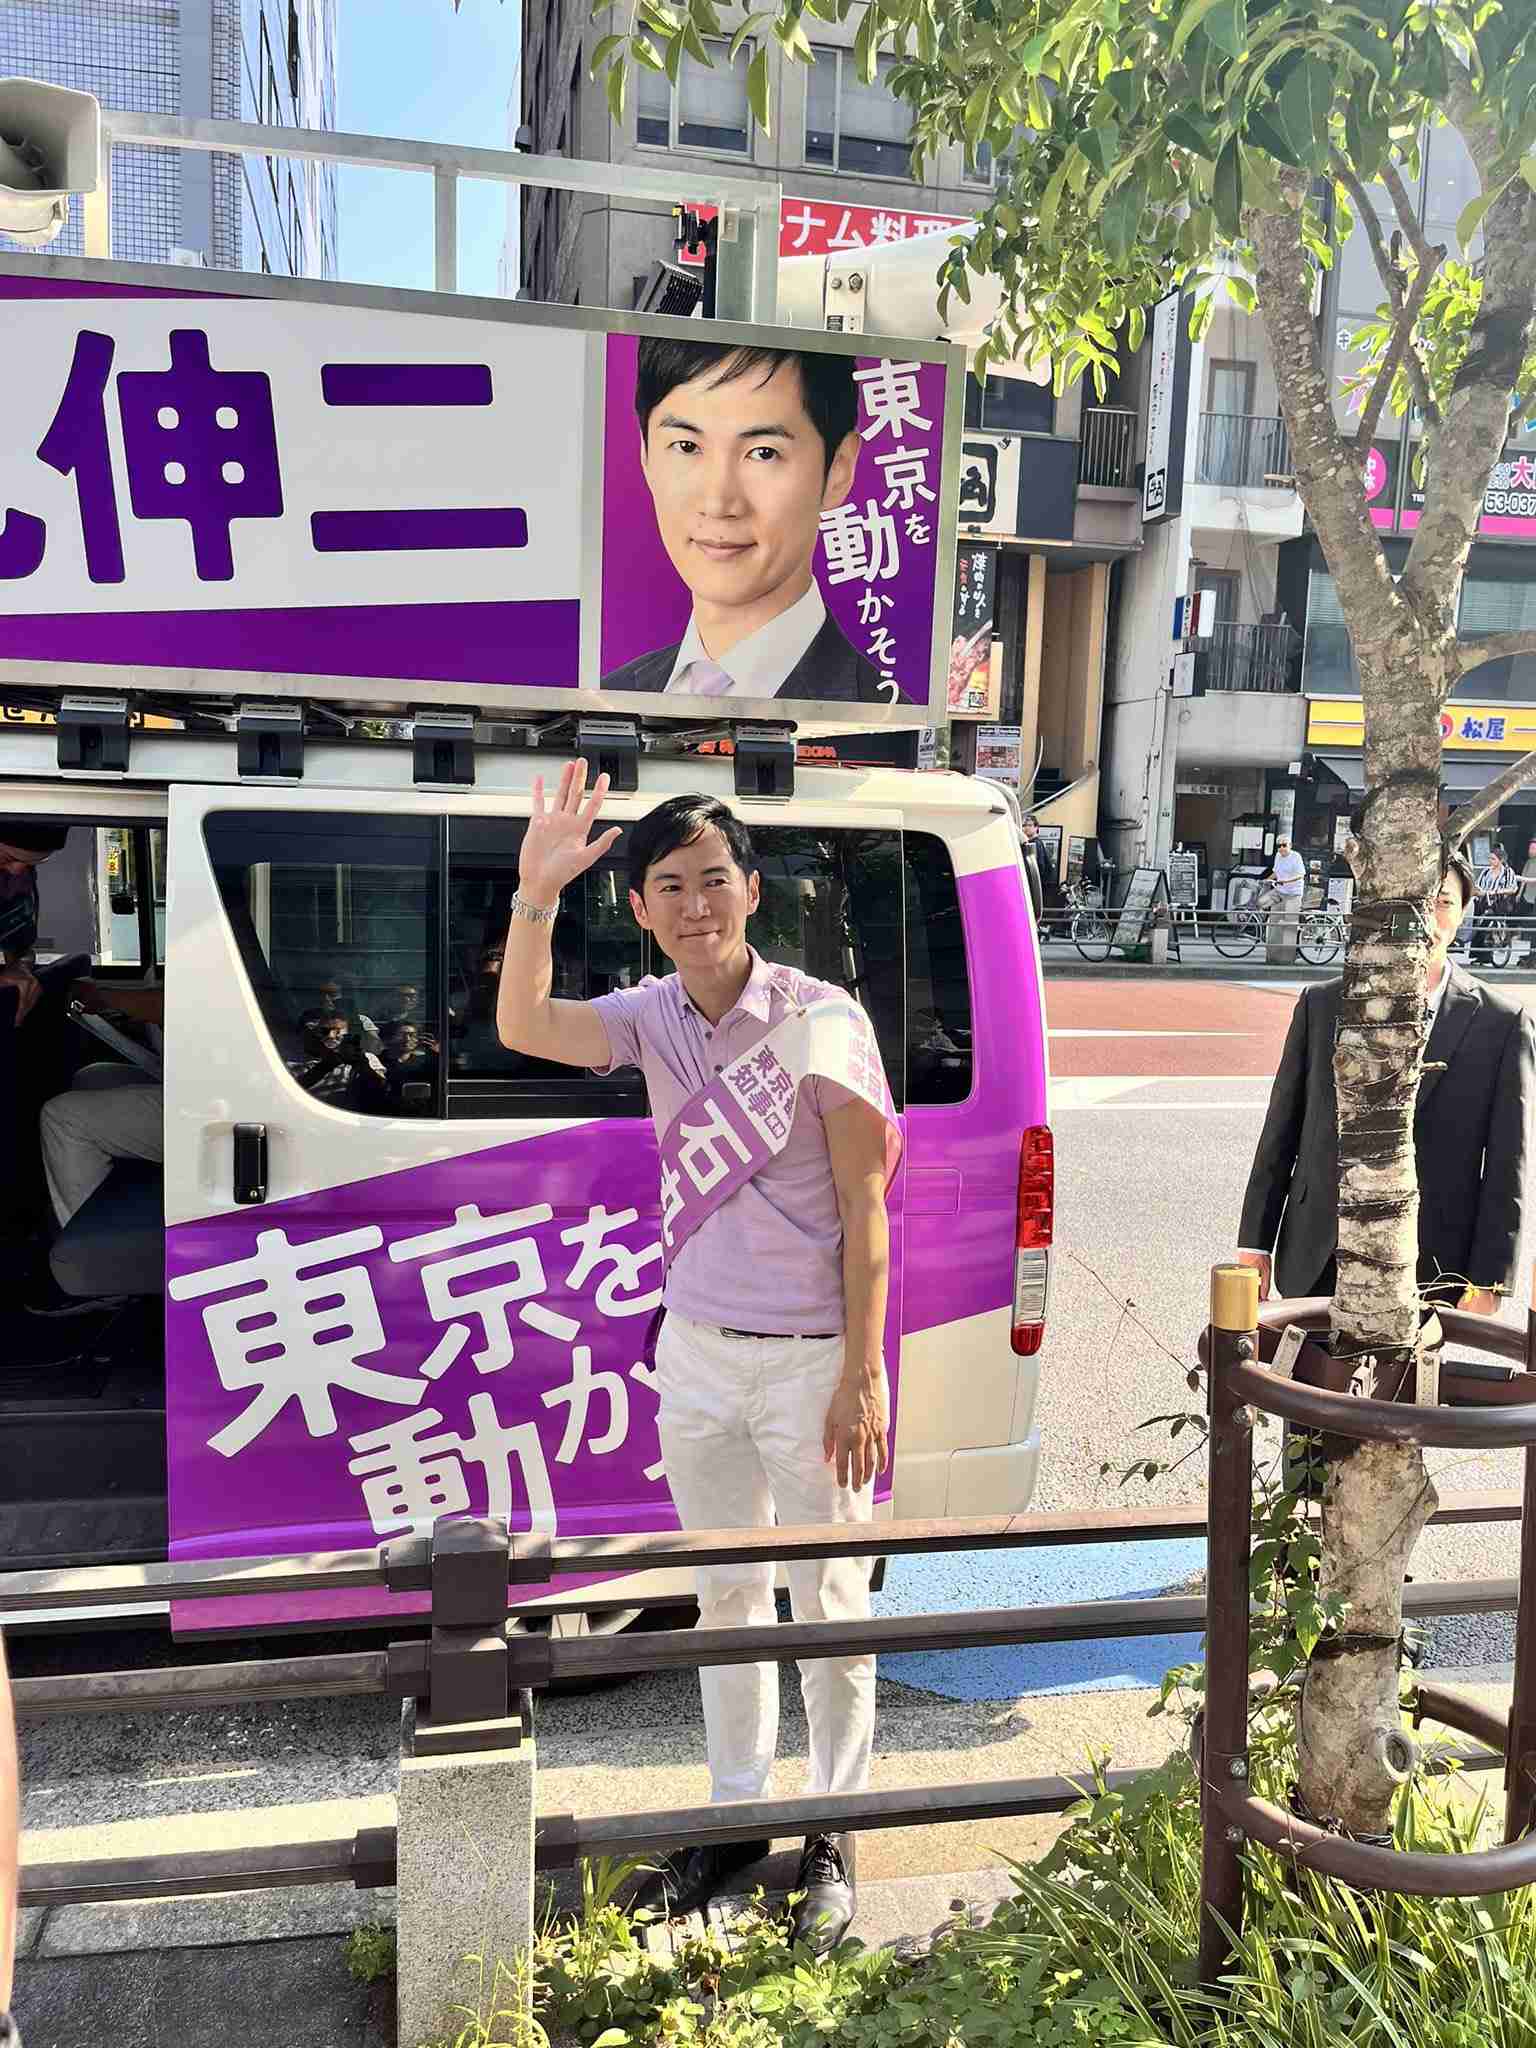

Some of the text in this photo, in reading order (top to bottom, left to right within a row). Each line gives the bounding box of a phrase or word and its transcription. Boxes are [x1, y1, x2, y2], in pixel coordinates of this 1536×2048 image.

[778, 205, 953, 250] ナム料
[0, 329, 529, 584] 伸二
[853, 358, 936, 545] 東京を
[1511, 455, 1536, 490] 大
[819, 499, 902, 705] 動かそう
[1461, 717, 1505, 740] 松屋
[168, 1203, 664, 1458] 東京を
[348, 1345, 669, 1538] 動か
